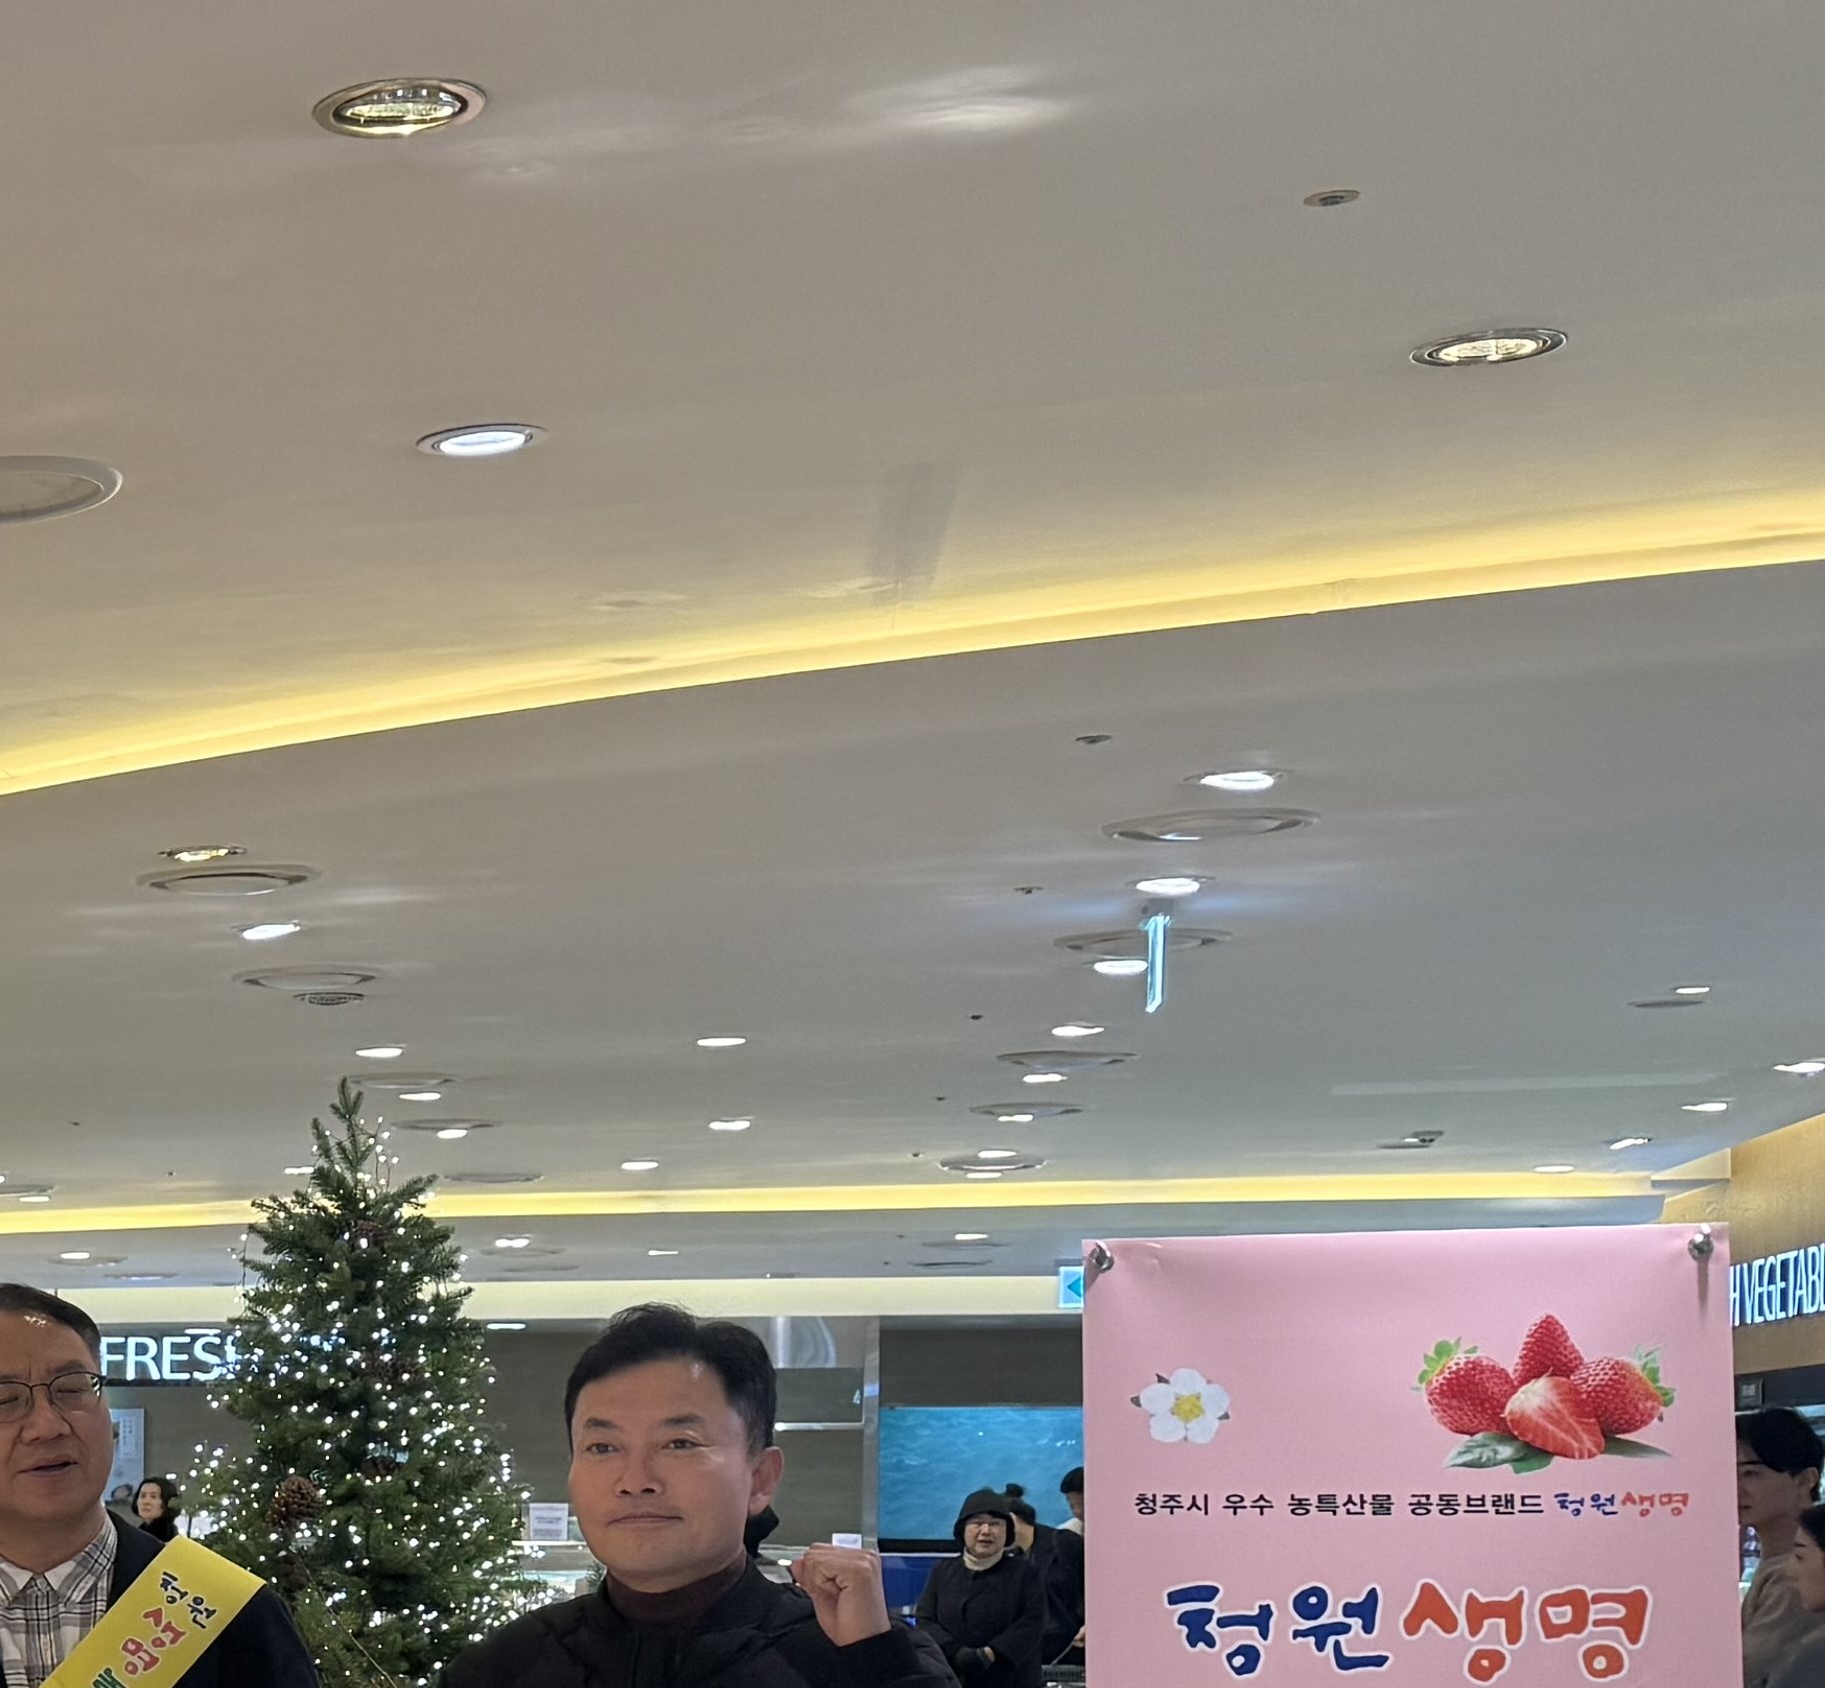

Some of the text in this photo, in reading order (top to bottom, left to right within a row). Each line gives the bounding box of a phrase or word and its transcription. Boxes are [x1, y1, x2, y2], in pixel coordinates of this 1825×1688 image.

[1133, 1492, 1210, 1517] 청주시
[1221, 1492, 1275, 1516] 우수
[1287, 1492, 1395, 1517] 농특산물
[1407, 1492, 1545, 1517] 공동브랜드
[159, 1570, 218, 1630] 청원
[1165, 1580, 1651, 1682] 청원생명
[120, 1606, 188, 1676] 생명
